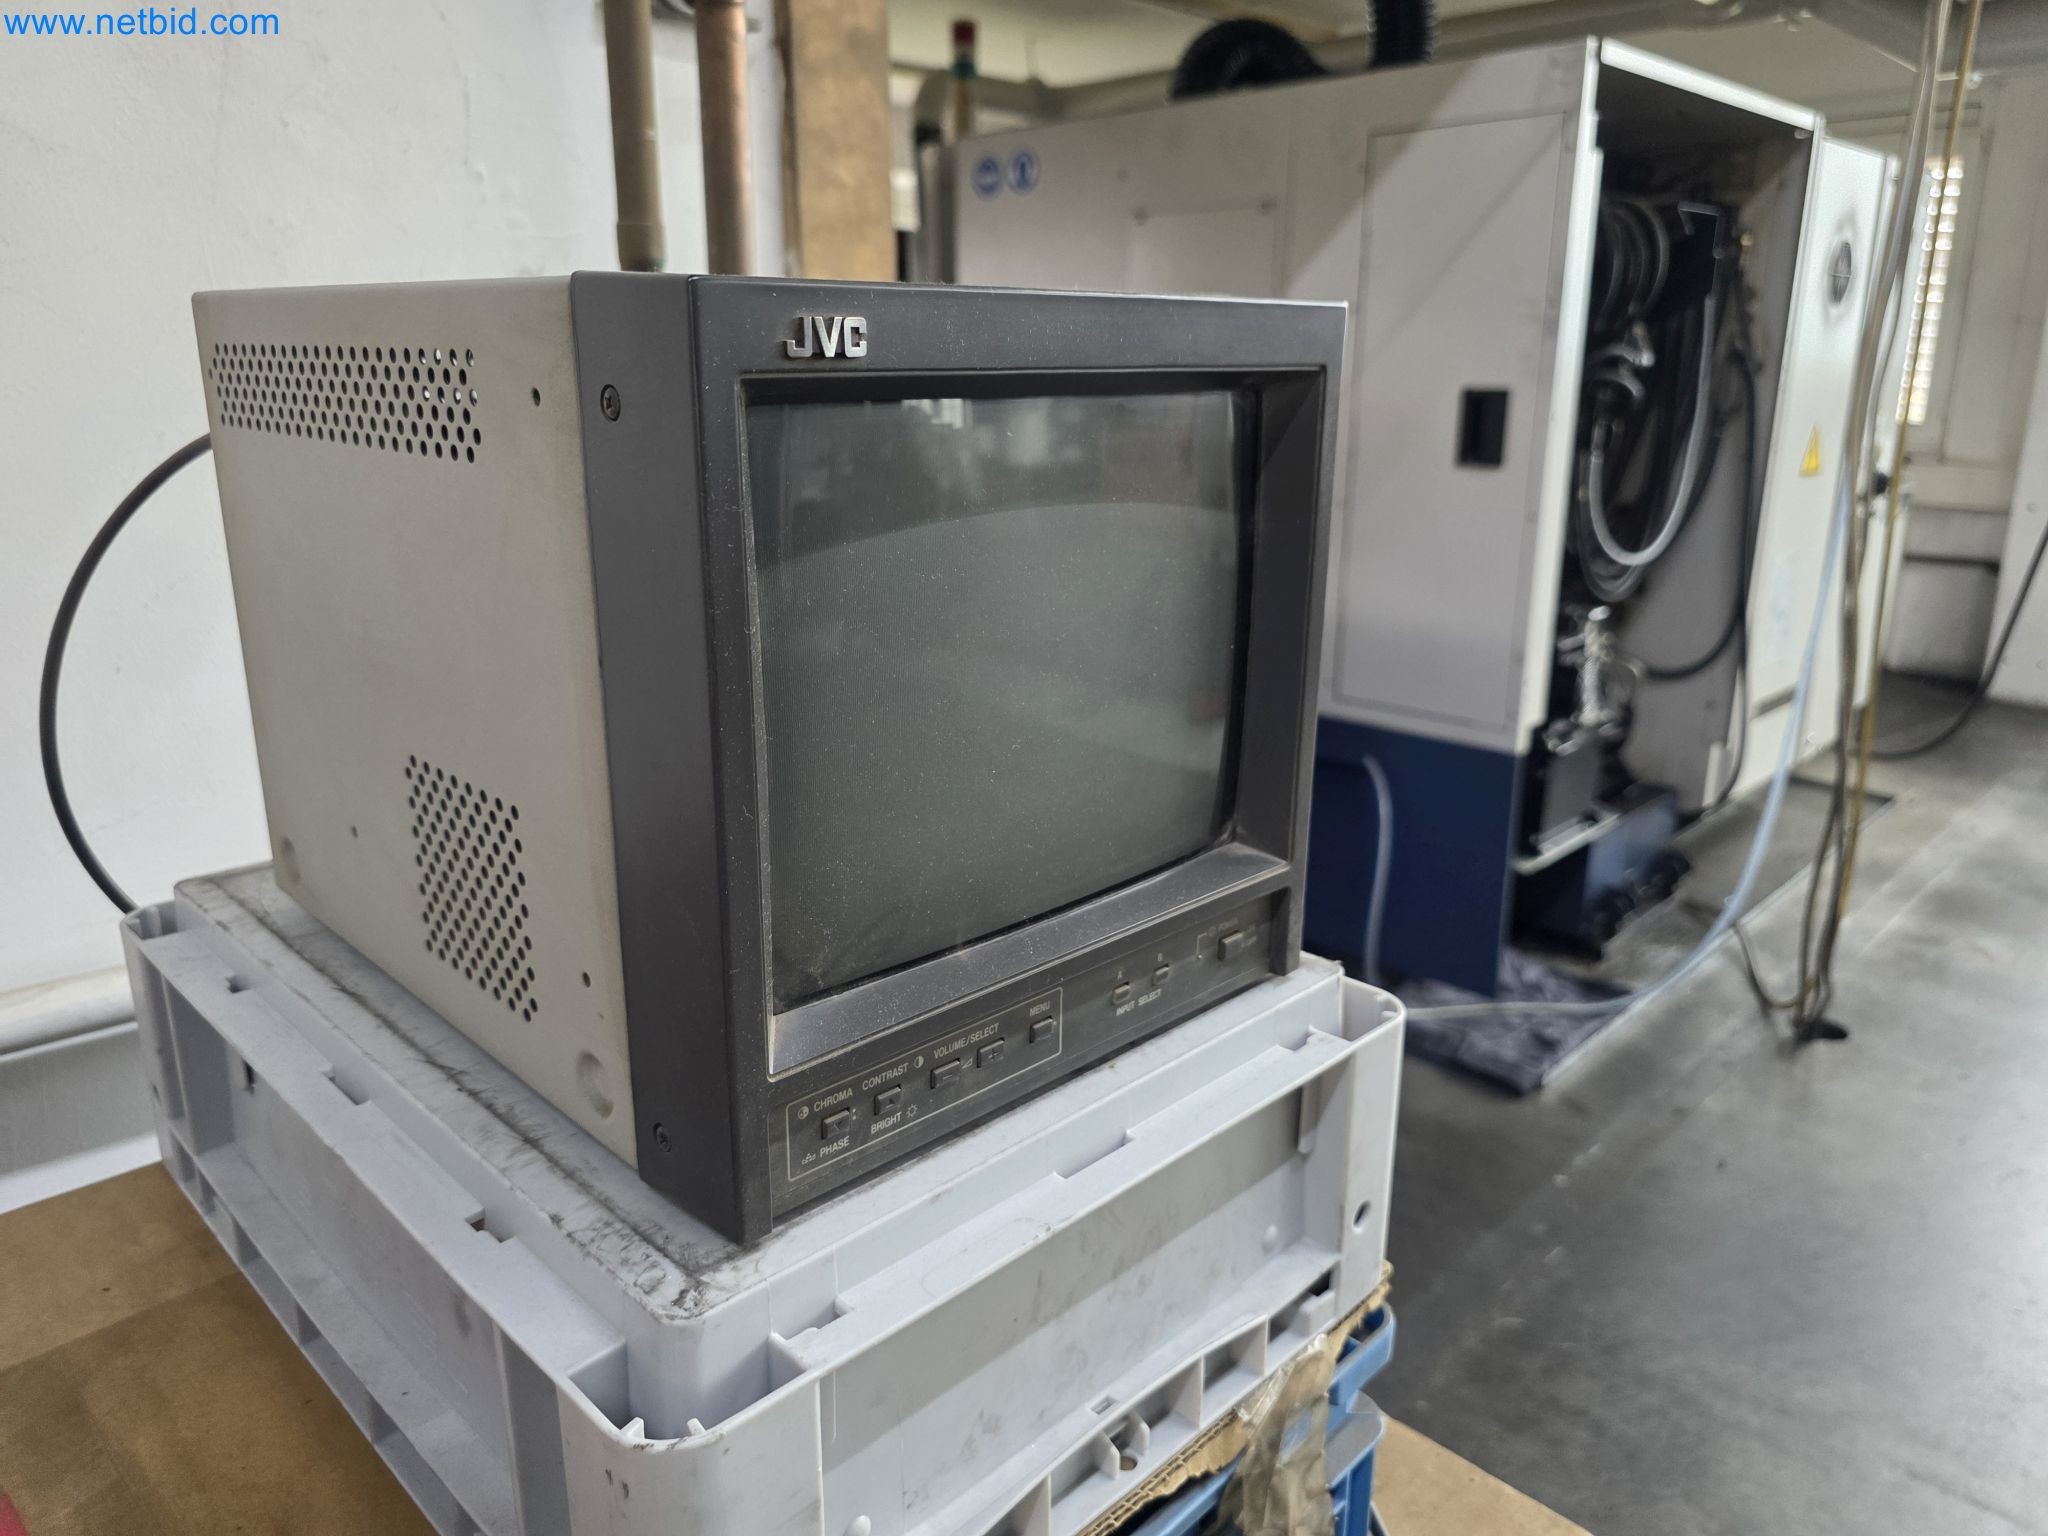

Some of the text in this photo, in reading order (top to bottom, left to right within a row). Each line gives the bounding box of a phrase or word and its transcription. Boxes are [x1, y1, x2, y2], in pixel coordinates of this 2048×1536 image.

[785, 315, 868, 358] JVC
[1029, 1001, 1051, 1017] MENU
[1116, 988, 1162, 1016] INPUT SELECT
[933, 1022, 1000, 1060] VOLUME/SELECT
[862, 1064, 909, 1091] CONTRAST
[813, 1087, 853, 1113] CHROMA
[870, 1111, 902, 1136] BRIGHT
[819, 1135, 850, 1159] PHASE
